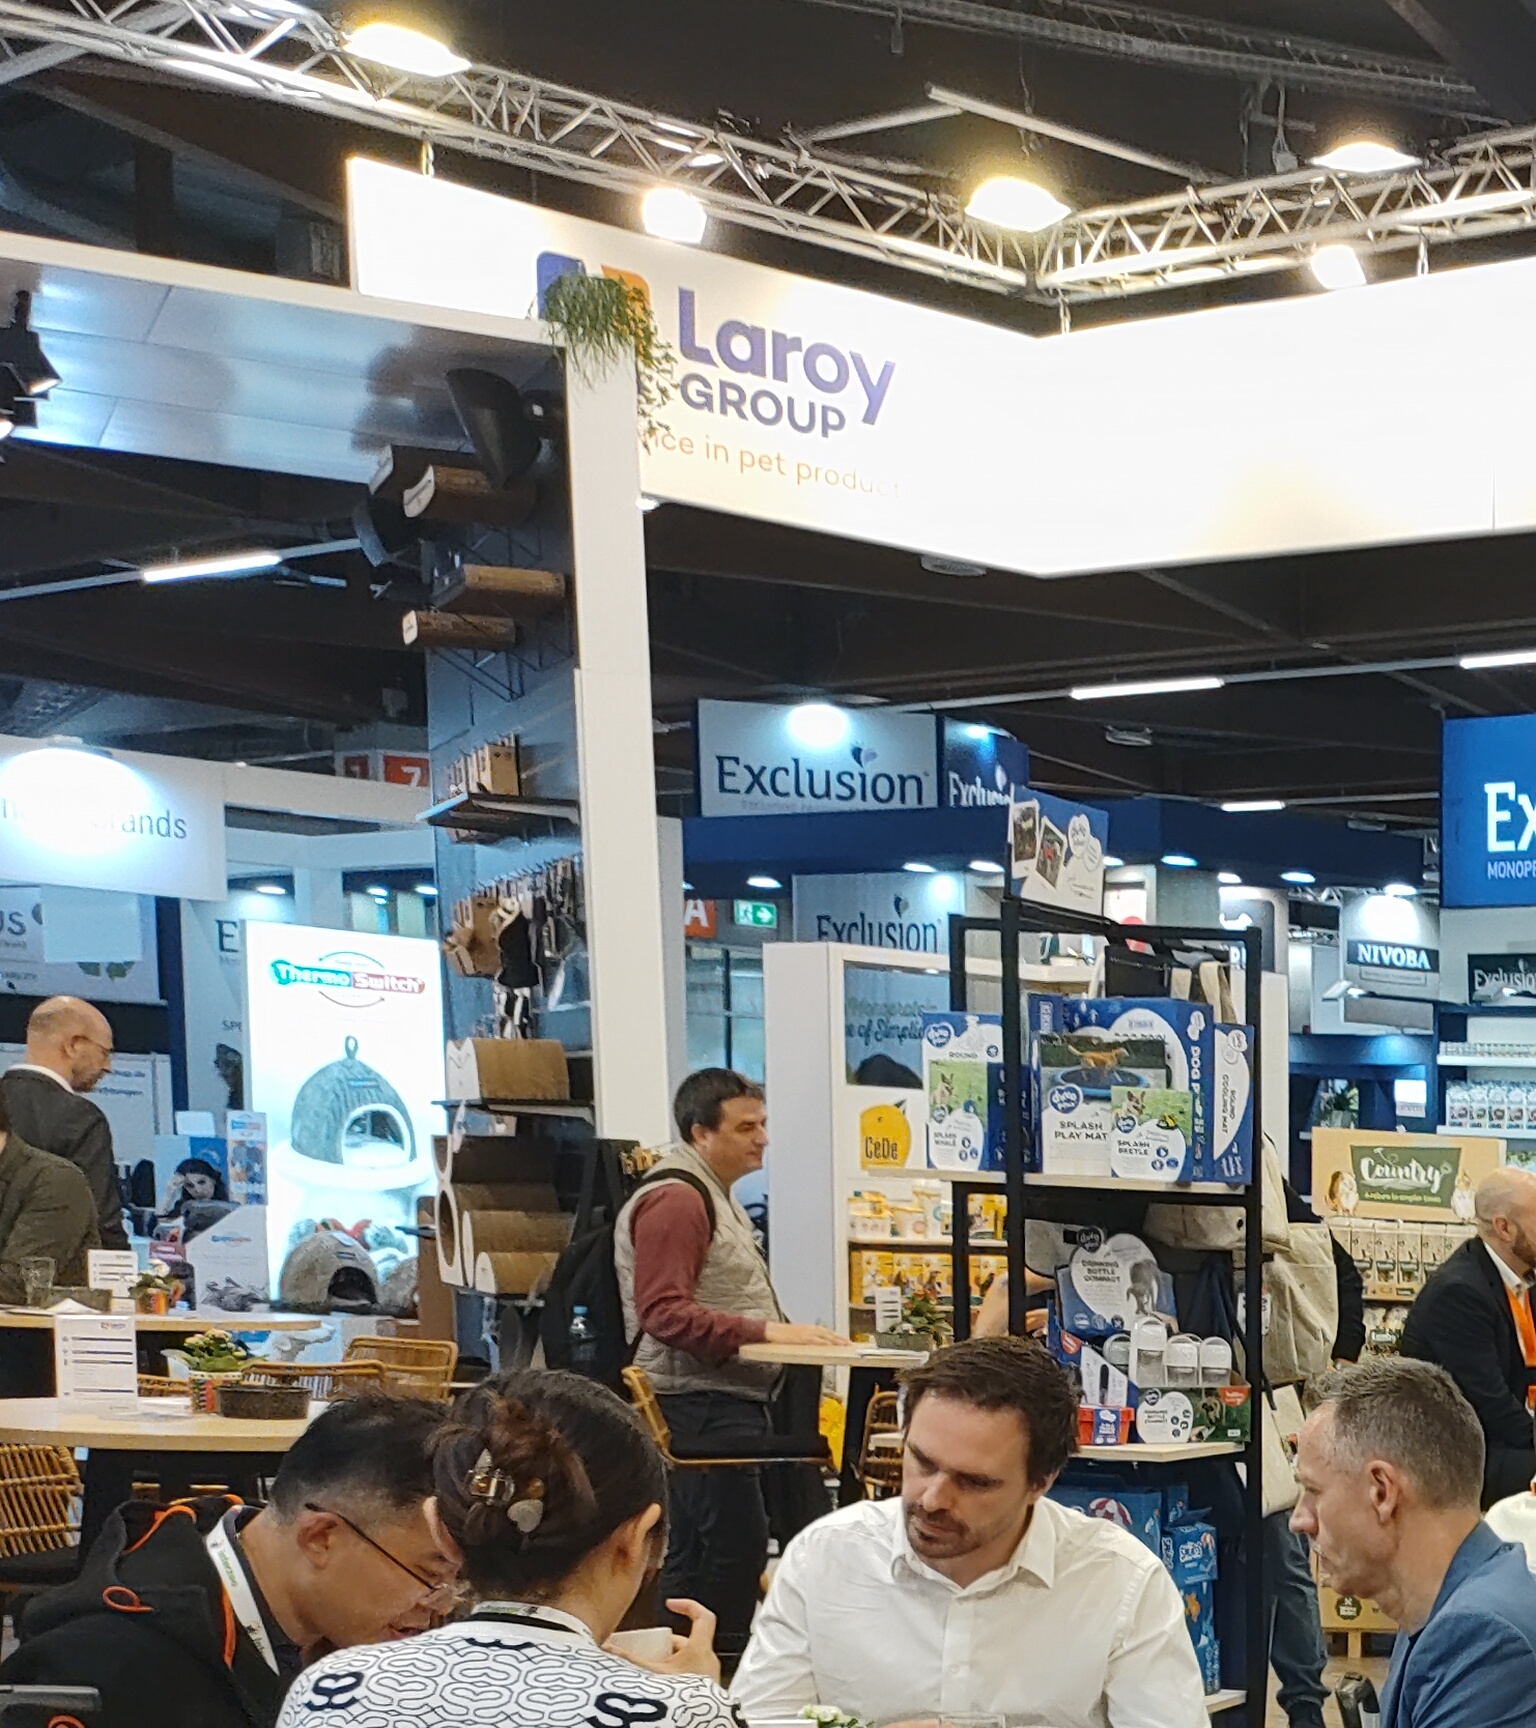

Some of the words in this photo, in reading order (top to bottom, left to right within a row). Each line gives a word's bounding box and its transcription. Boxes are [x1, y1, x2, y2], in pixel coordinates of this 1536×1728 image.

[678, 286, 897, 426] Laroy
[679, 371, 847, 438] GROUP
[705, 433, 729, 464] in
[739, 449, 787, 476] pet
[715, 754, 924, 806] Exclusion
[684, 898, 709, 928] A
[816, 912, 938, 952] Exclusion
[1357, 942, 1432, 970] NIVOBA
[353, 972, 420, 993] Switch
[1054, 1131, 1082, 1141] PLAY
[1085, 1131, 1108, 1141] MAT
[1059, 1120, 1103, 1131] SPLASH
[1360, 1156, 1441, 1194] Country
